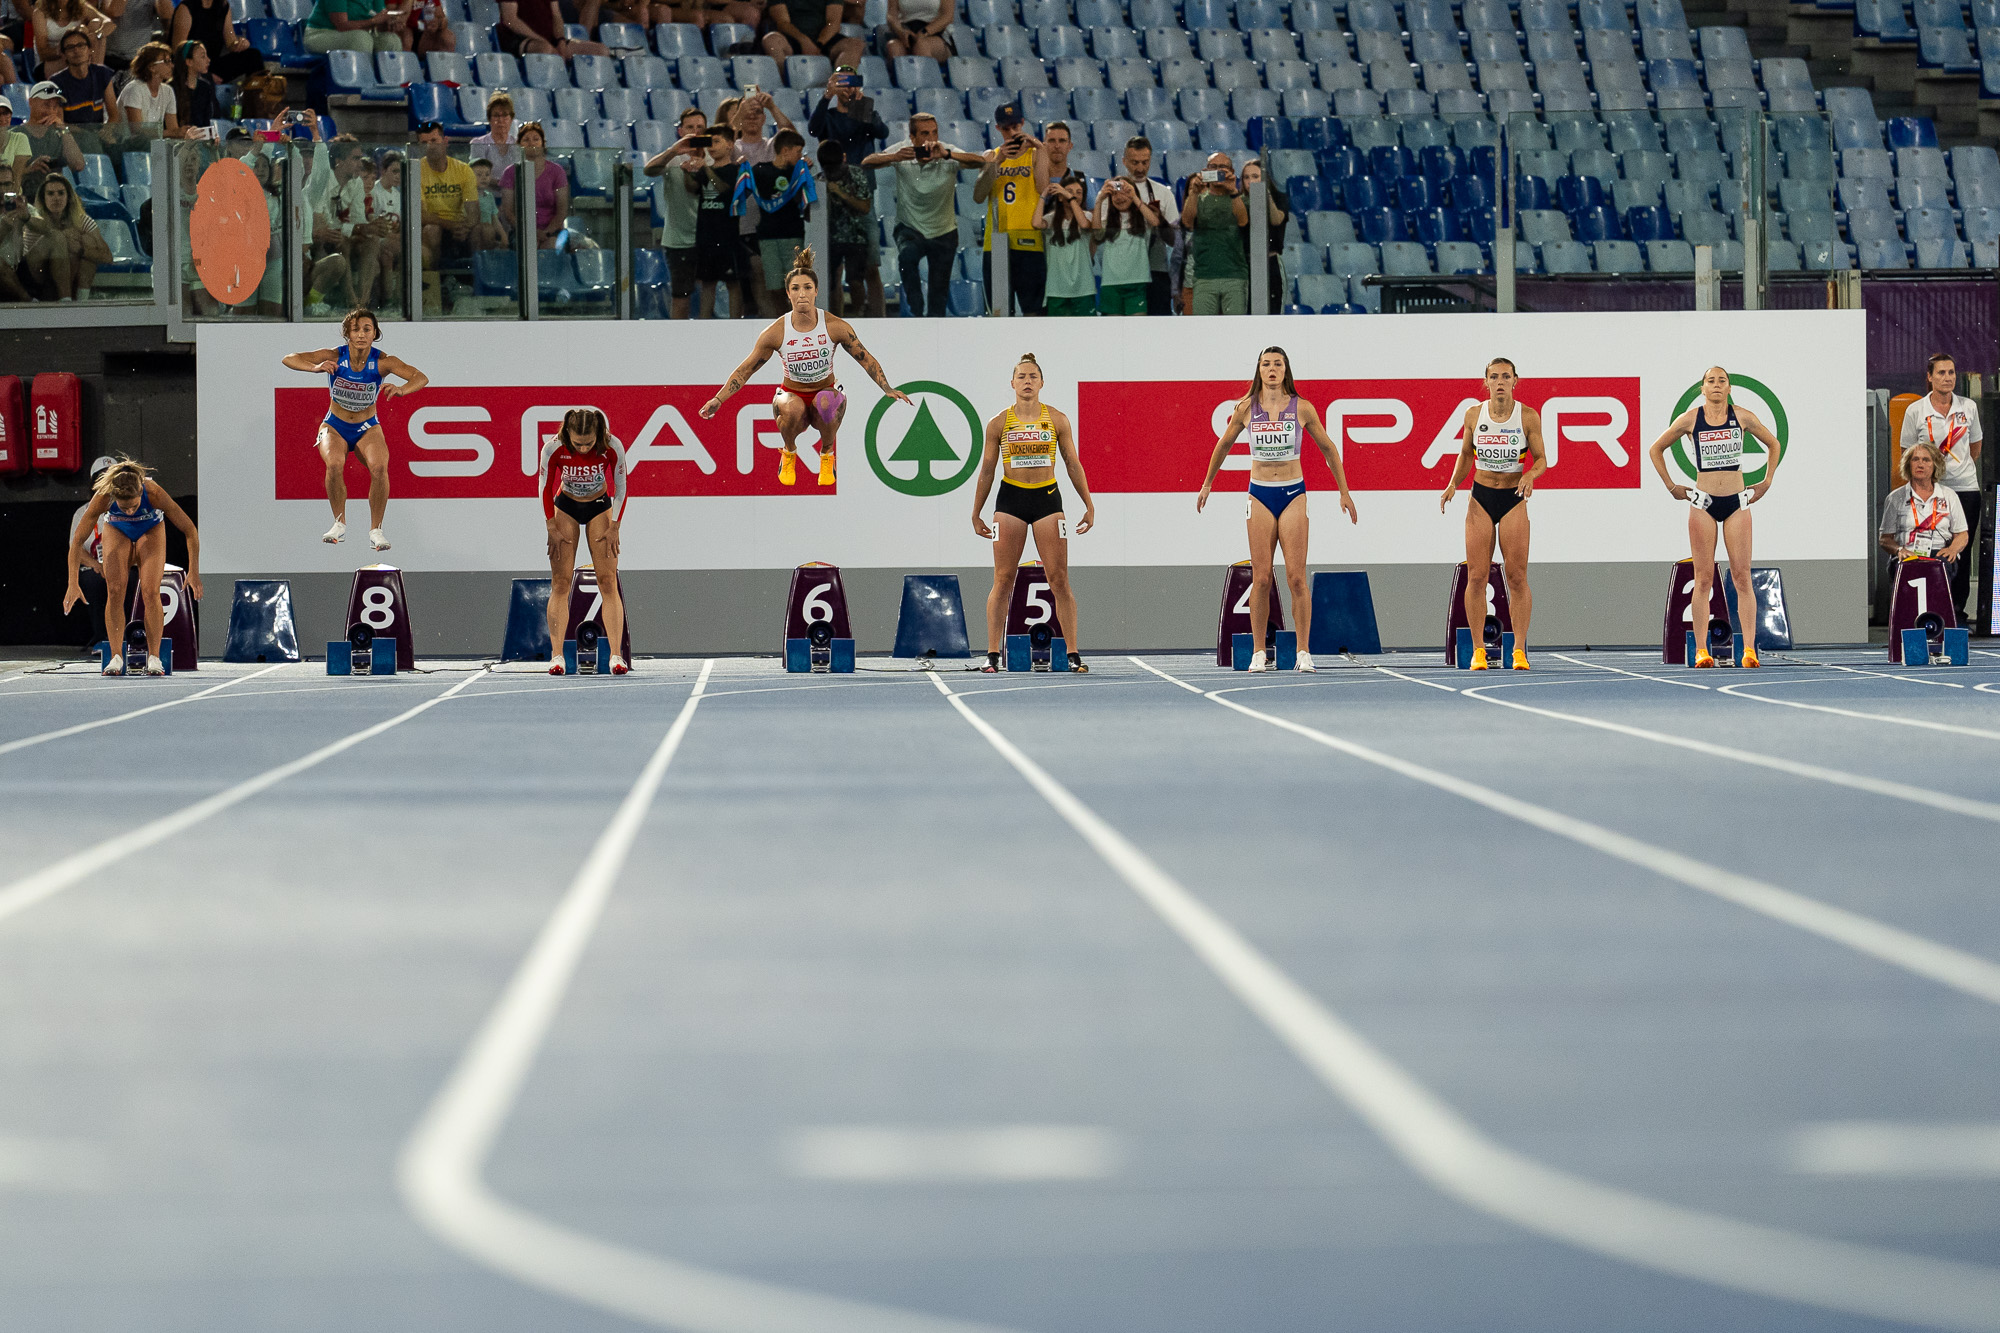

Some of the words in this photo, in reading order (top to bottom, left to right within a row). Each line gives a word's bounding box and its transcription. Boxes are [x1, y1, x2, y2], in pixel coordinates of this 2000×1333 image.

[997, 165, 1031, 177] AKERS
[424, 183, 462, 194] adidas
[1003, 182, 1016, 204] 6
[788, 351, 819, 361] SPAR
[788, 358, 829, 373] SWOBODA
[335, 379, 366, 391] SPAR
[333, 388, 374, 401] EMMANOUILIDOU
[1252, 423, 1283, 431] SPAR
[408, 404, 821, 478] SPAR
[1008, 433, 1039, 441] SPAR
[1256, 434, 1289, 444] HUNT
[1700, 431, 1731, 440] SPAR
[1477, 449, 1518, 458] ROSIUS
[1701, 442, 1741, 455] FOTOPOULOU
[562, 463, 605, 476] SUISSE
[562, 473, 593, 482] SPAR
[1692, 492, 1699, 505] 2
[992, 525, 997, 539] 5
[1062, 523, 1067, 536] 5
[1907, 577, 1927, 615] 1
[160, 585, 179, 626] 9
[360, 586, 395, 629] 8
[579, 585, 603, 621] 7
[802, 583, 834, 625] 6
[1024, 582, 1052, 625] 5
